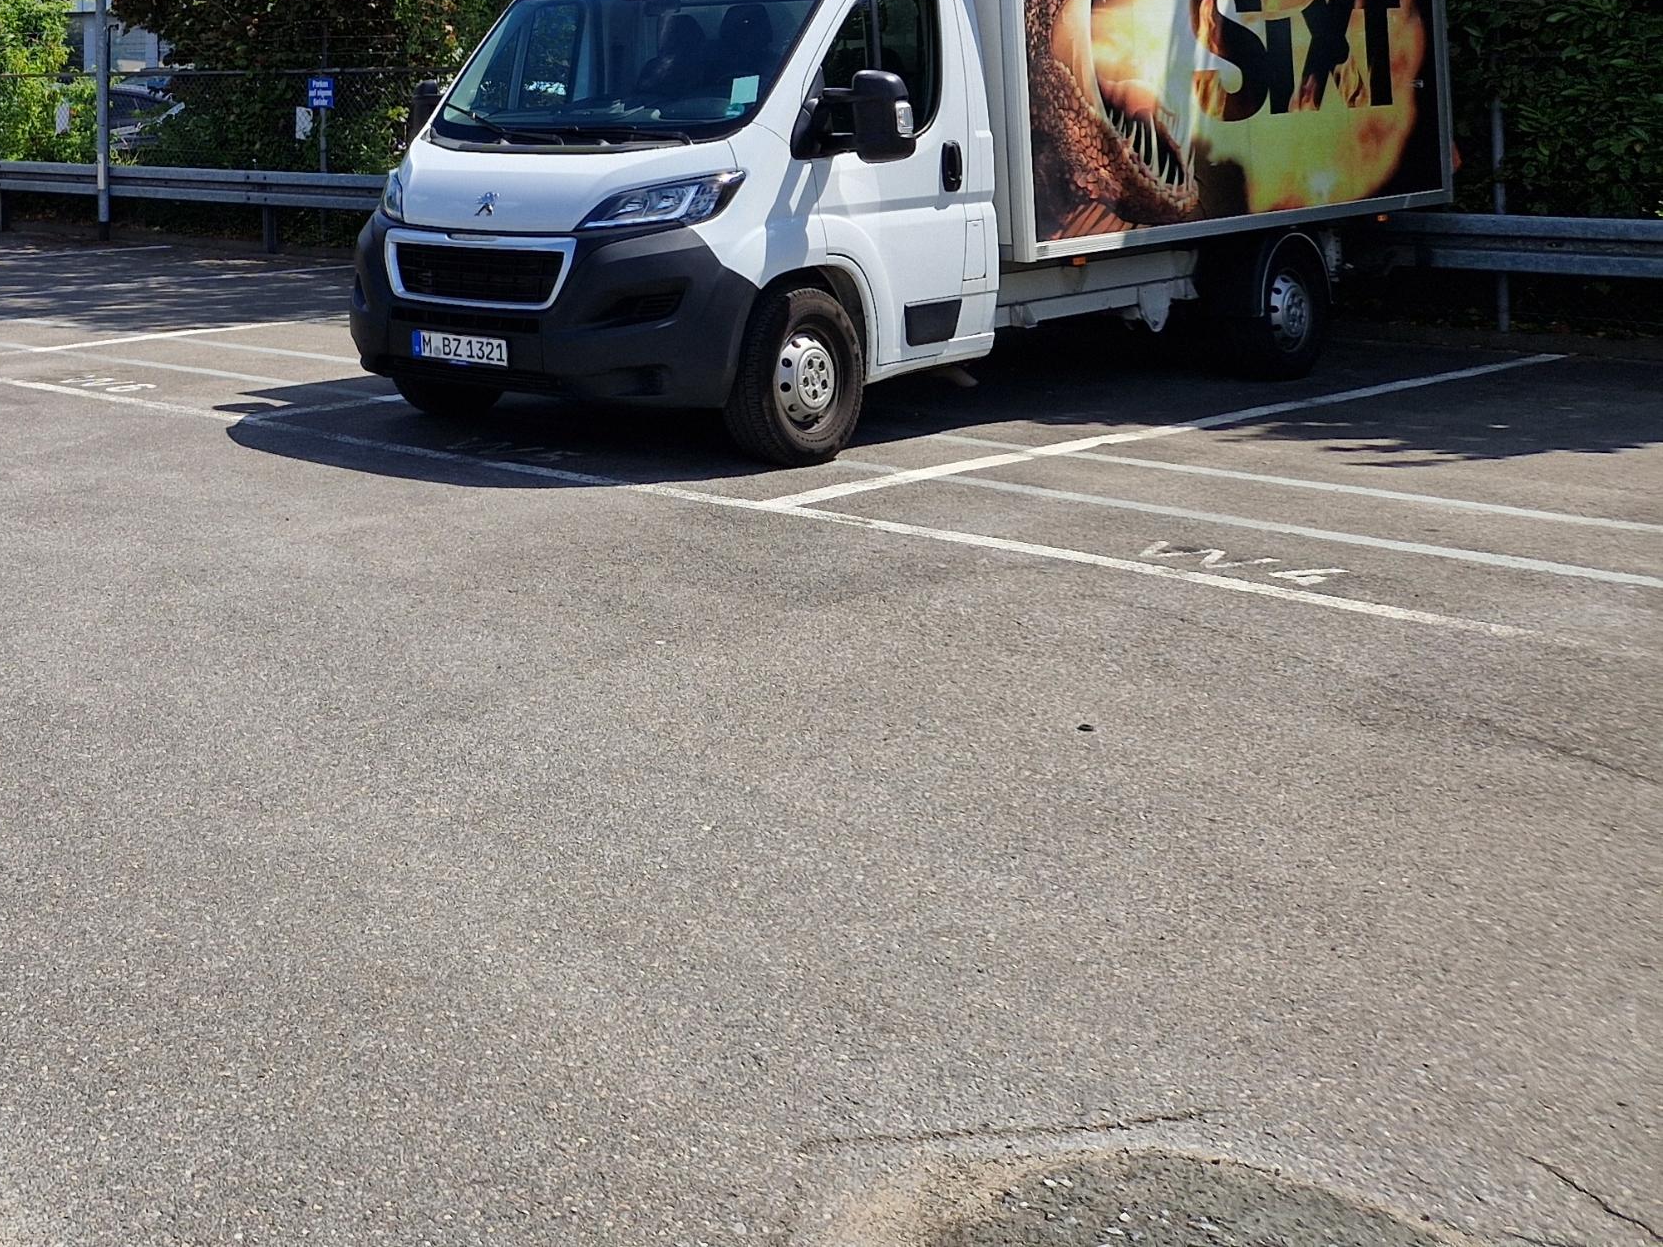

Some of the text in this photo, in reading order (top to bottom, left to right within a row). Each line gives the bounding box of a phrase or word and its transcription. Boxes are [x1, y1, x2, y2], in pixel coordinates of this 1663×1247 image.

[422, 334, 506, 363] M BZ 1321
